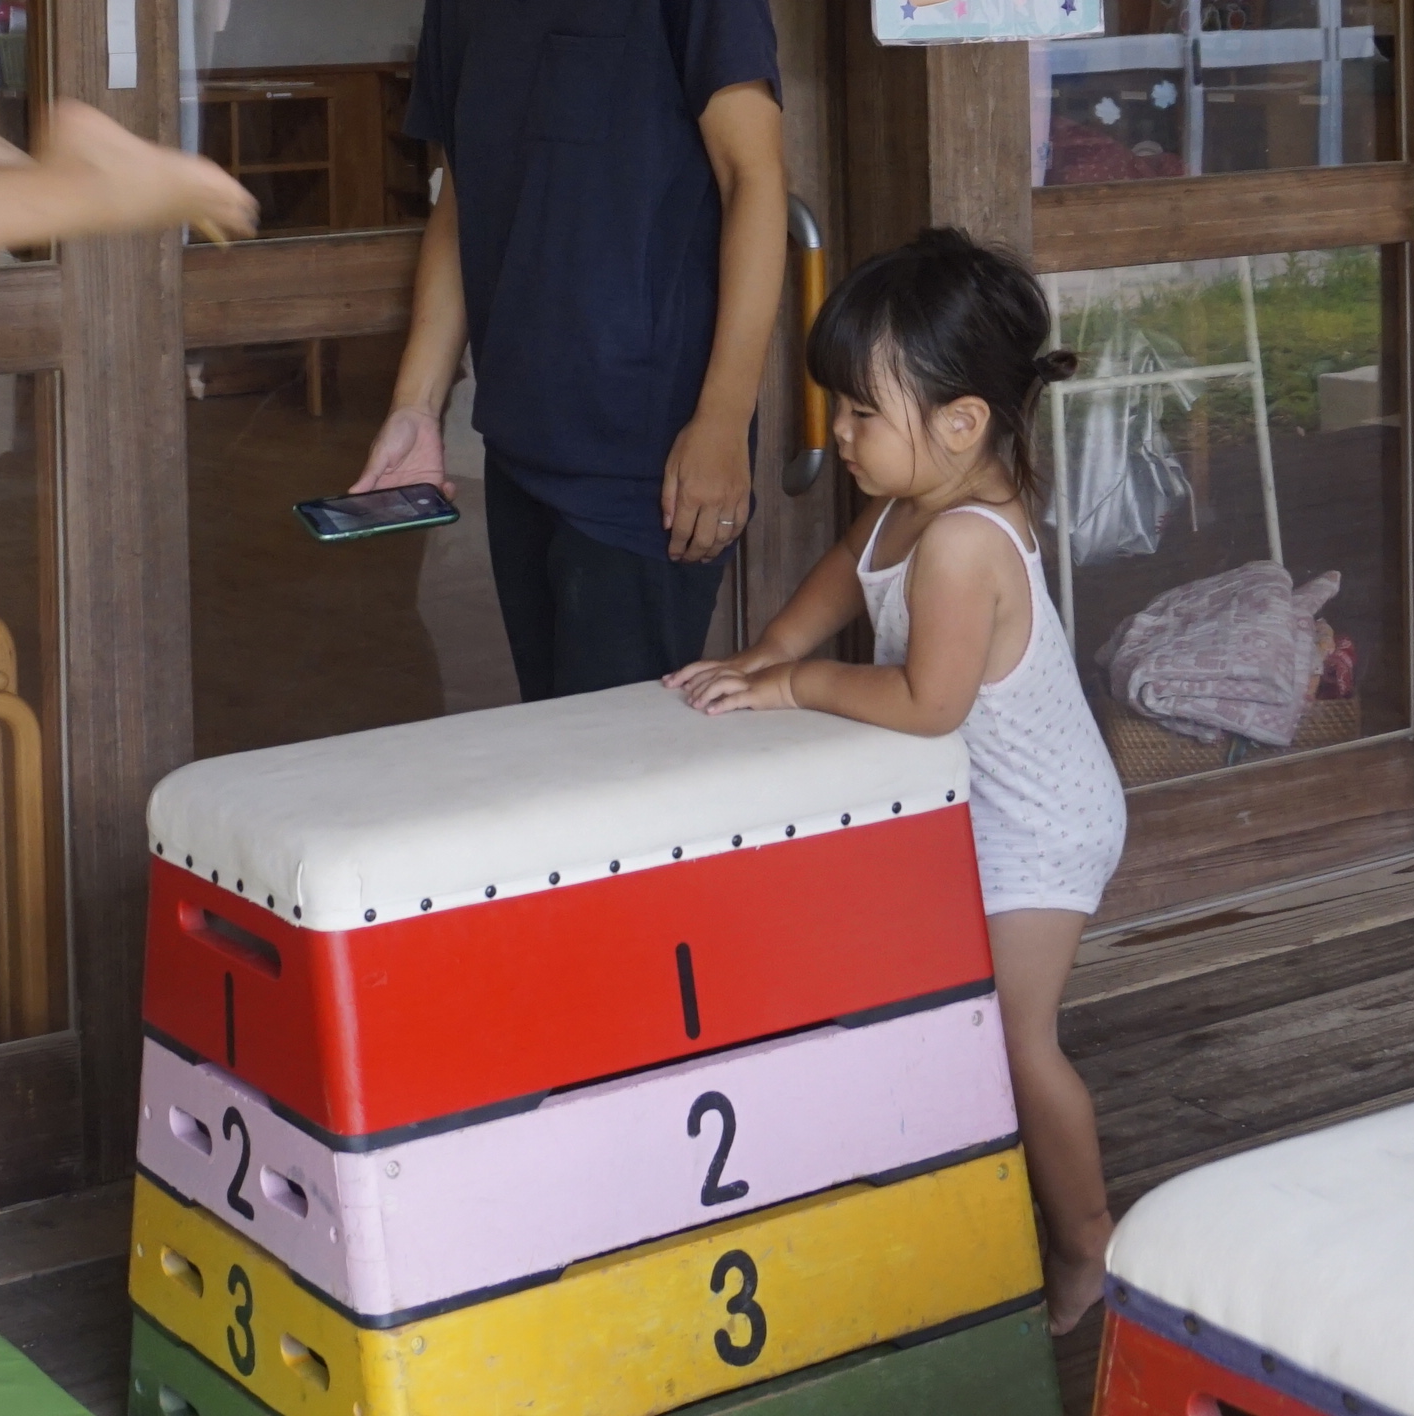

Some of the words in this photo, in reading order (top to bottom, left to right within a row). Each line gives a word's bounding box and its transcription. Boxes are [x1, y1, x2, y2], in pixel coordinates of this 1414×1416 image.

[224, 970, 235, 1068] 1
[676, 942, 701, 1040] 1
[222, 1106, 254, 1221] 2
[687, 1091, 750, 1207] 2
[226, 1264, 256, 1377] 3
[709, 1249, 767, 1367] 3
